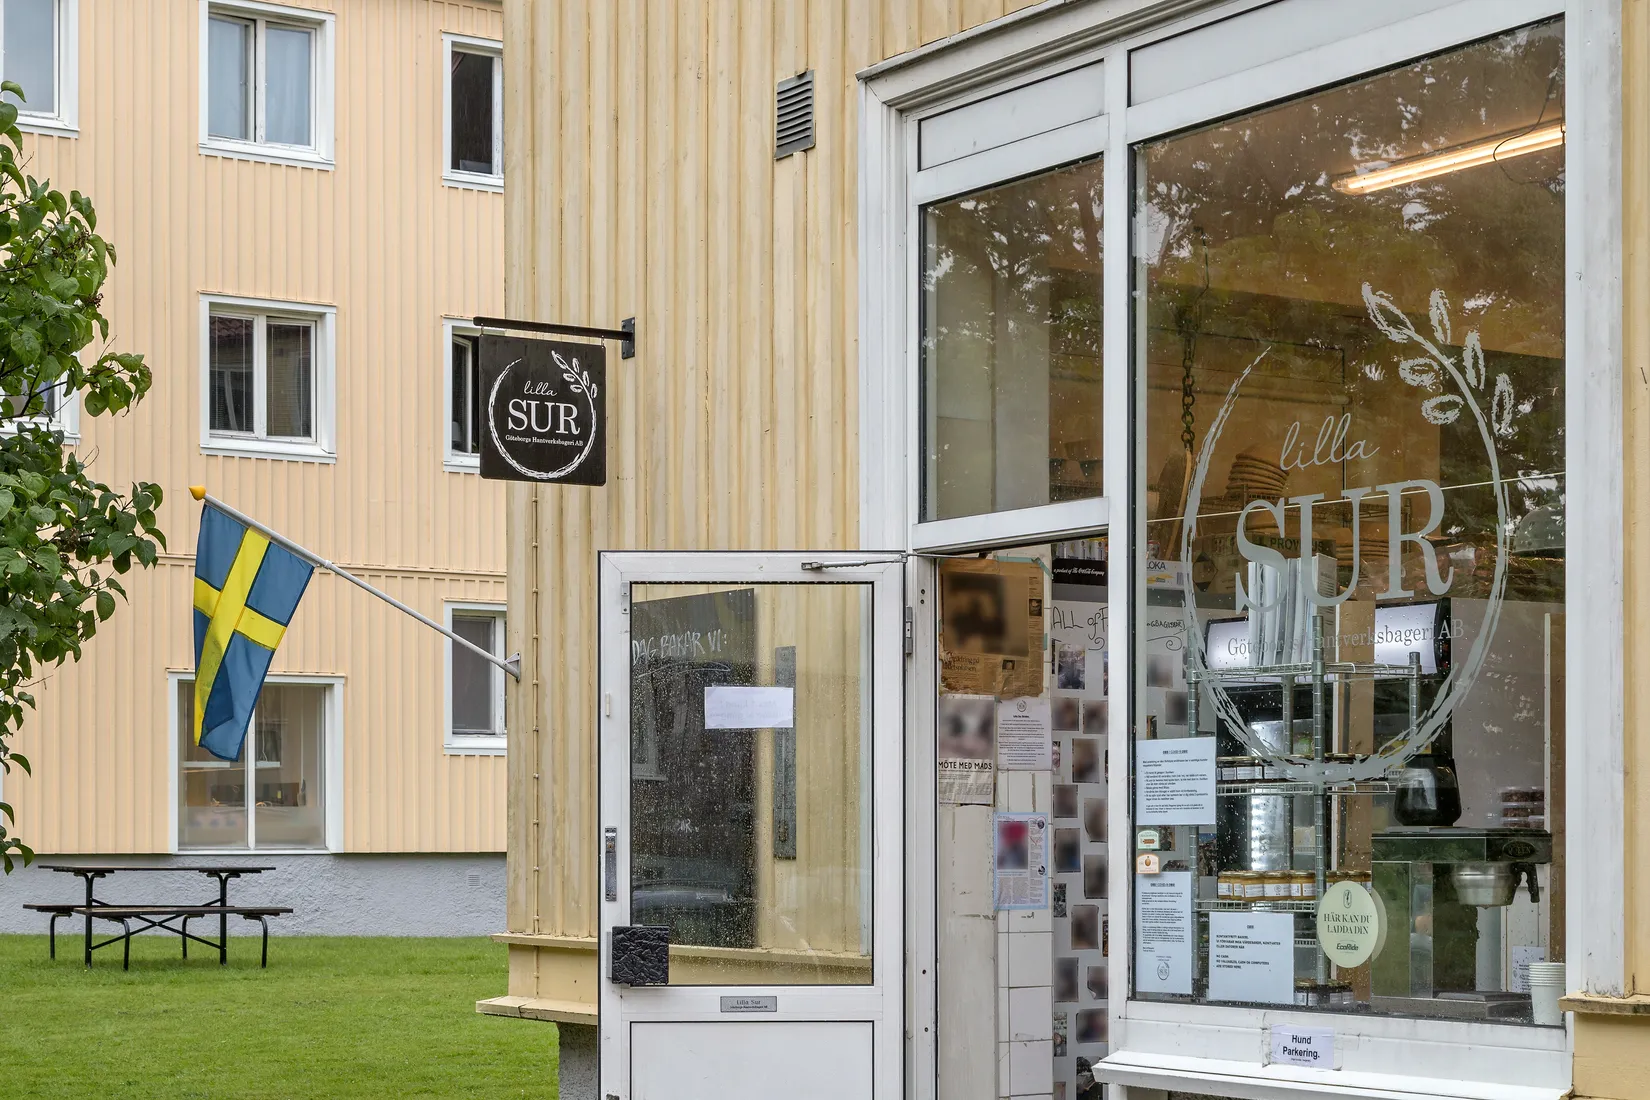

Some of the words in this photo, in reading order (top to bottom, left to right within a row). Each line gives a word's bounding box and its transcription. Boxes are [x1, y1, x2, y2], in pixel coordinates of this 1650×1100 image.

[523, 380, 557, 397] lilla
[508, 398, 581, 435] SUR
[1279, 412, 1381, 471] lilla
[1235, 479, 1454, 614] SUR
[1438, 618, 1465, 640] AB
[631, 636, 659, 667] DAG
[660, 630, 706, 659] BAKAR
[959, 761, 973, 770] MED
[974, 762, 993, 770] MADS
[1323, 911, 1341, 923] HÄR
[1342, 913, 1360, 923] KAN
[1360, 914, 1373, 924] DU
[1327, 924, 1353, 934] LADDA
[1354, 925, 1369, 935] DIN
[1336, 942, 1359, 951] EcoRide
[1291, 1034, 1312, 1045] Hund
